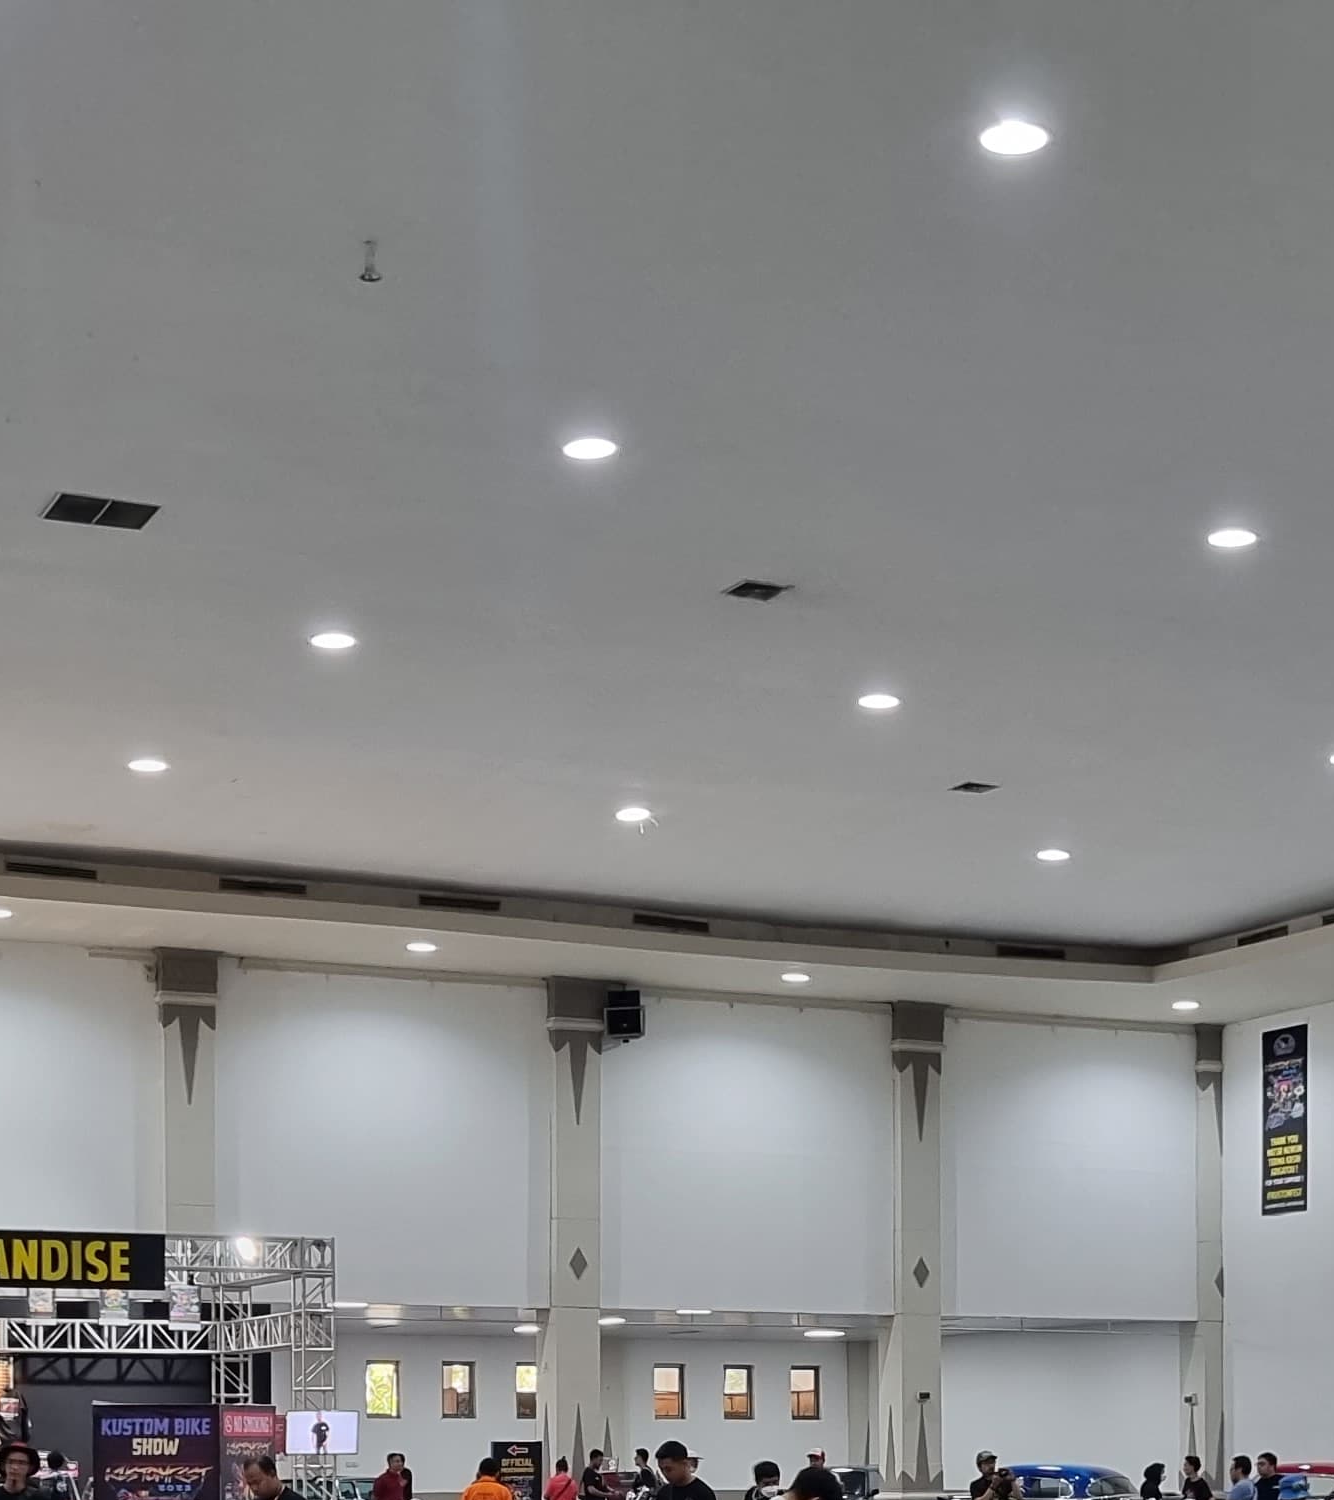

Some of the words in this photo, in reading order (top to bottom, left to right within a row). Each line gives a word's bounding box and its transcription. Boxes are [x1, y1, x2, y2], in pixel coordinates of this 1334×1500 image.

[100, 1417, 170, 1436] KUSTOM
[174, 1417, 211, 1436] BIKE
[132, 1438, 179, 1456] SHOW
